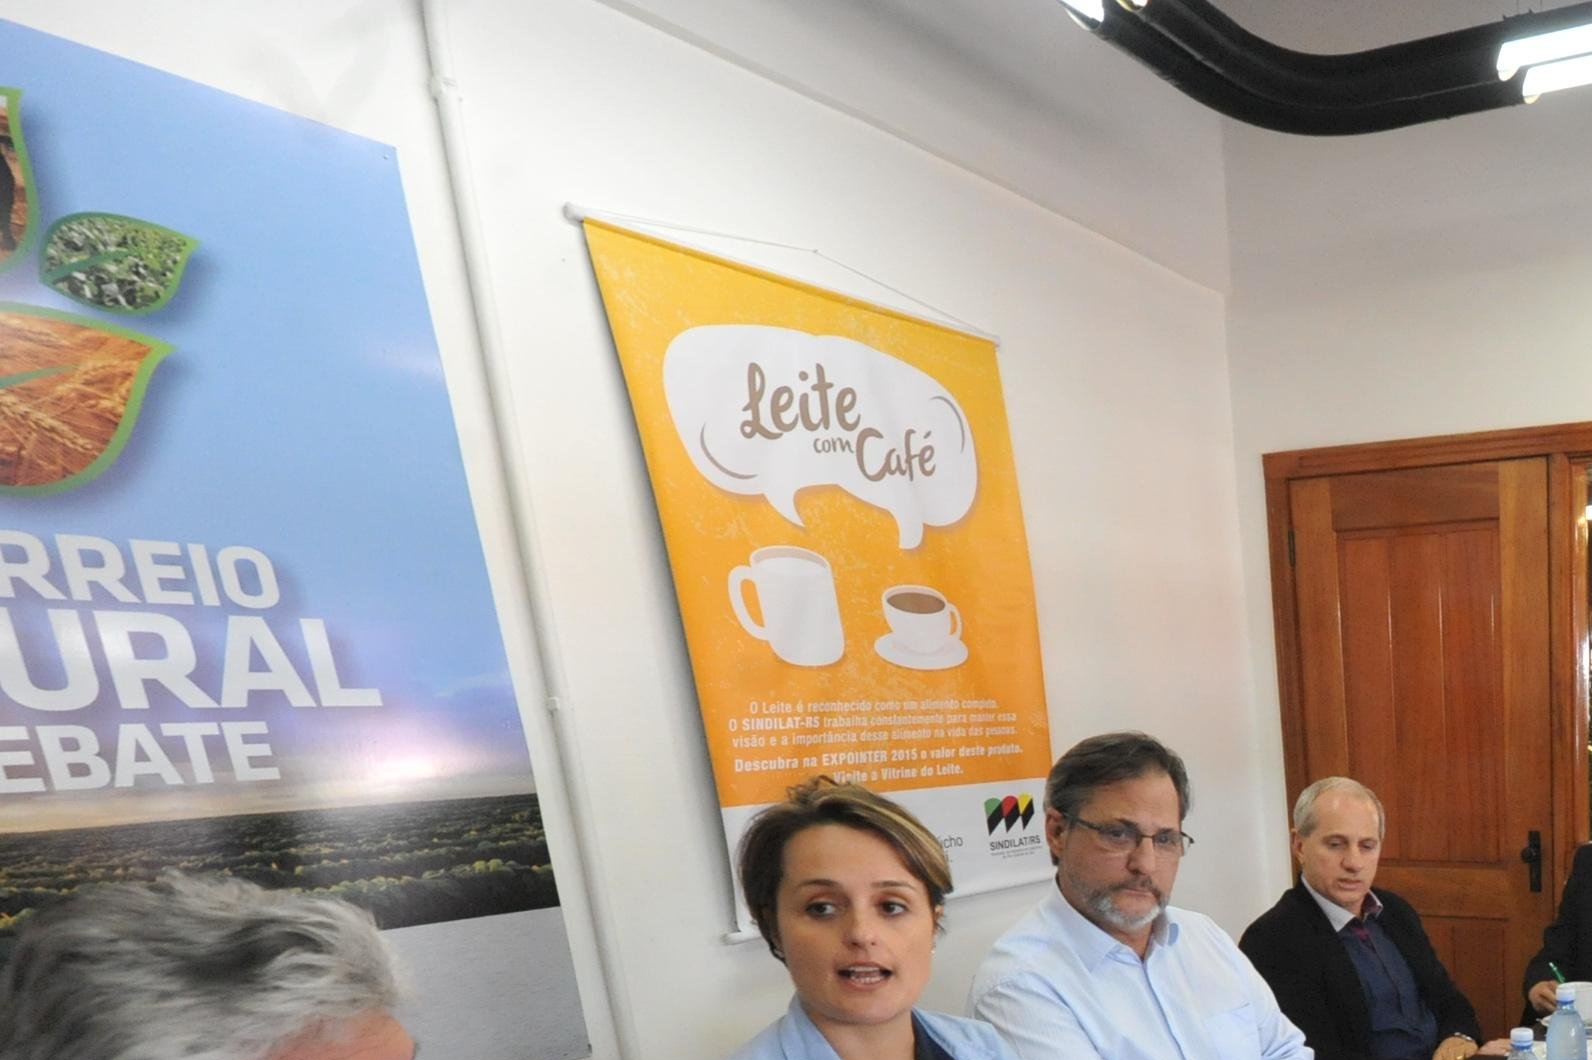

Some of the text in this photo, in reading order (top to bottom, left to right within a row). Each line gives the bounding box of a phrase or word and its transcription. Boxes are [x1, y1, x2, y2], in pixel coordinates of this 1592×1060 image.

[738, 362, 862, 441] Leite
[813, 427, 936, 482] com Café
[0, 609, 384, 711] URAL
[750, 701, 759, 714] O
[762, 701, 792, 714] Leite
[807, 700, 873, 713] reconhecido
[875, 701, 900, 711] como
[920, 699, 960, 711] alimento
[729, 718, 738, 732] O
[742, 716, 820, 731] SINDILAT-RS
[823, 714, 868, 728] trabalha
[869, 713, 944, 726] constantemente
[732, 735, 765, 748] visão
[770, 737, 777, 746] e
[781, 736, 788, 746] a
[792, 731, 857, 746] importância
[861, 730, 888, 742] desse
[891, 728, 931, 741] alimento
[947, 727, 966, 738] vida
[0, 721, 281, 794] EBATE
[735, 756, 799, 773] Descubra
[803, 757, 817, 768] na
[822, 750, 888, 767] EXPOINTER
[891, 748, 918, 761] 2015
[920, 750, 928, 760] o
[930, 746, 956, 760] valor
[959, 744, 985, 758] deste
[881, 767, 918, 781] Vitrine
[921, 765, 934, 777] do
[936, 763, 964, 776] Leite.
